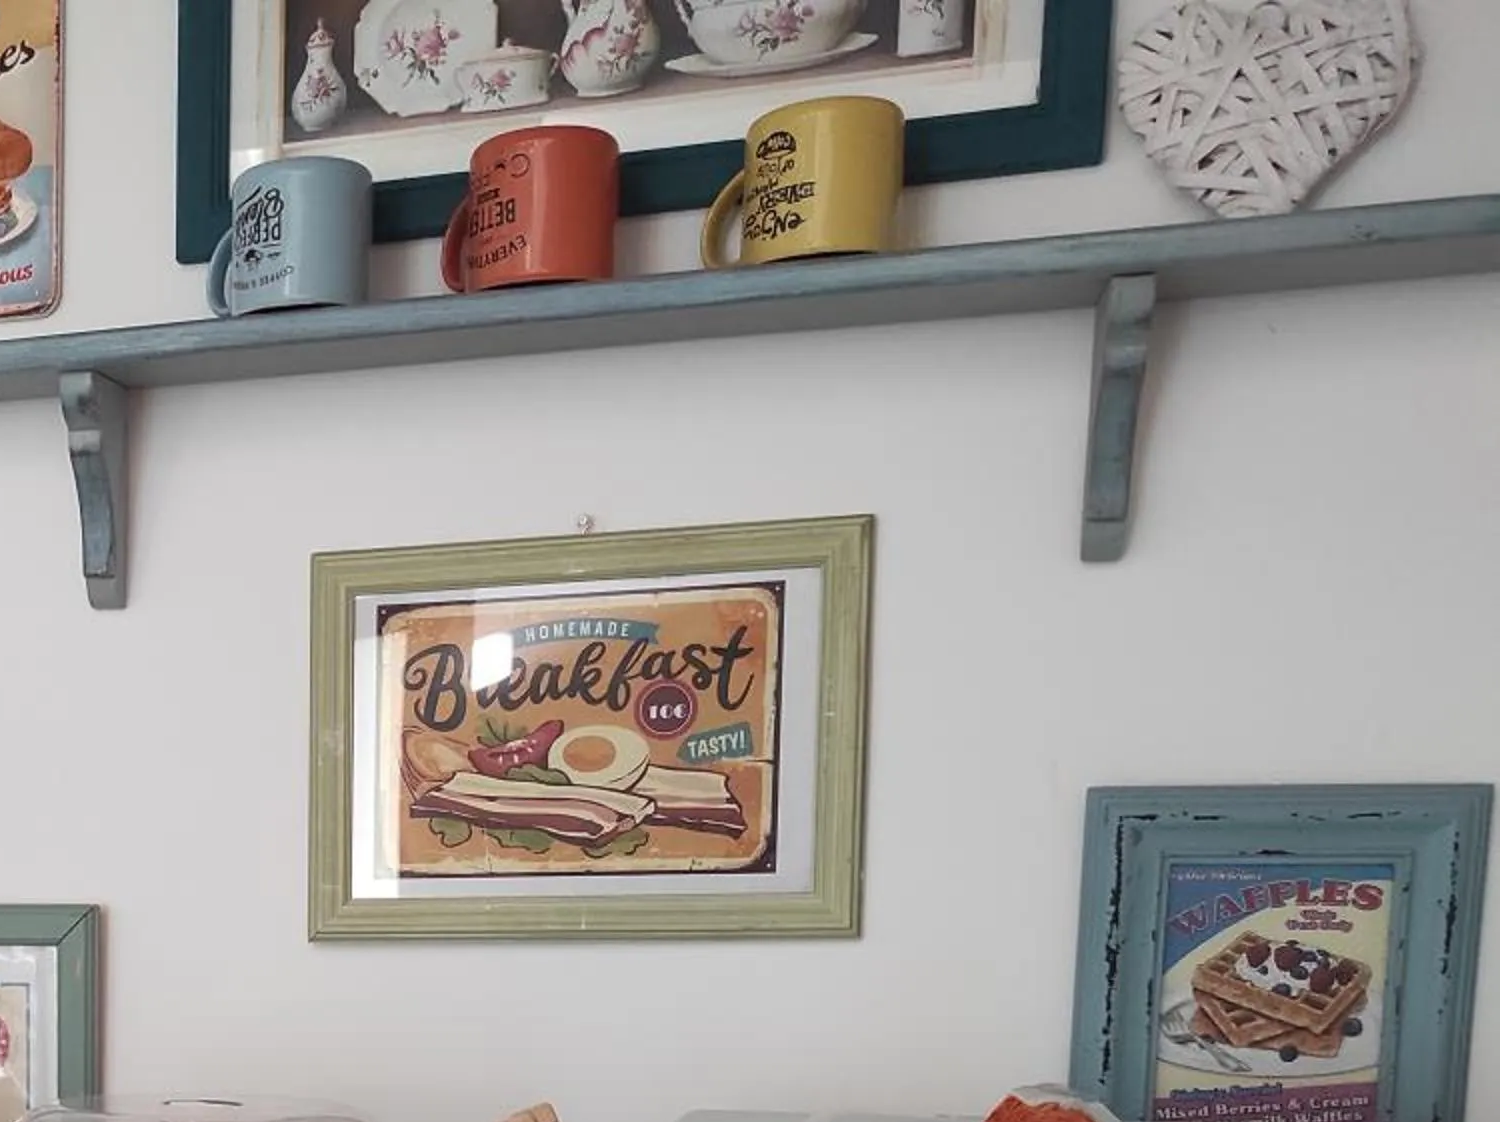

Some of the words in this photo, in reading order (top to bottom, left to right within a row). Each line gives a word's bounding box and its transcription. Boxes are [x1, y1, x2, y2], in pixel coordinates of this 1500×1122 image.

[524, 621, 631, 640] HOMEMADE
[687, 730, 747, 759] TASTY!
[1167, 878, 1384, 933] WAFFLES
[1156, 1104, 1209, 1120] Mixed
[1215, 1101, 1282, 1117] Berries
[1288, 1099, 1301, 1110] &
[1309, 1096, 1369, 1110] Cream
